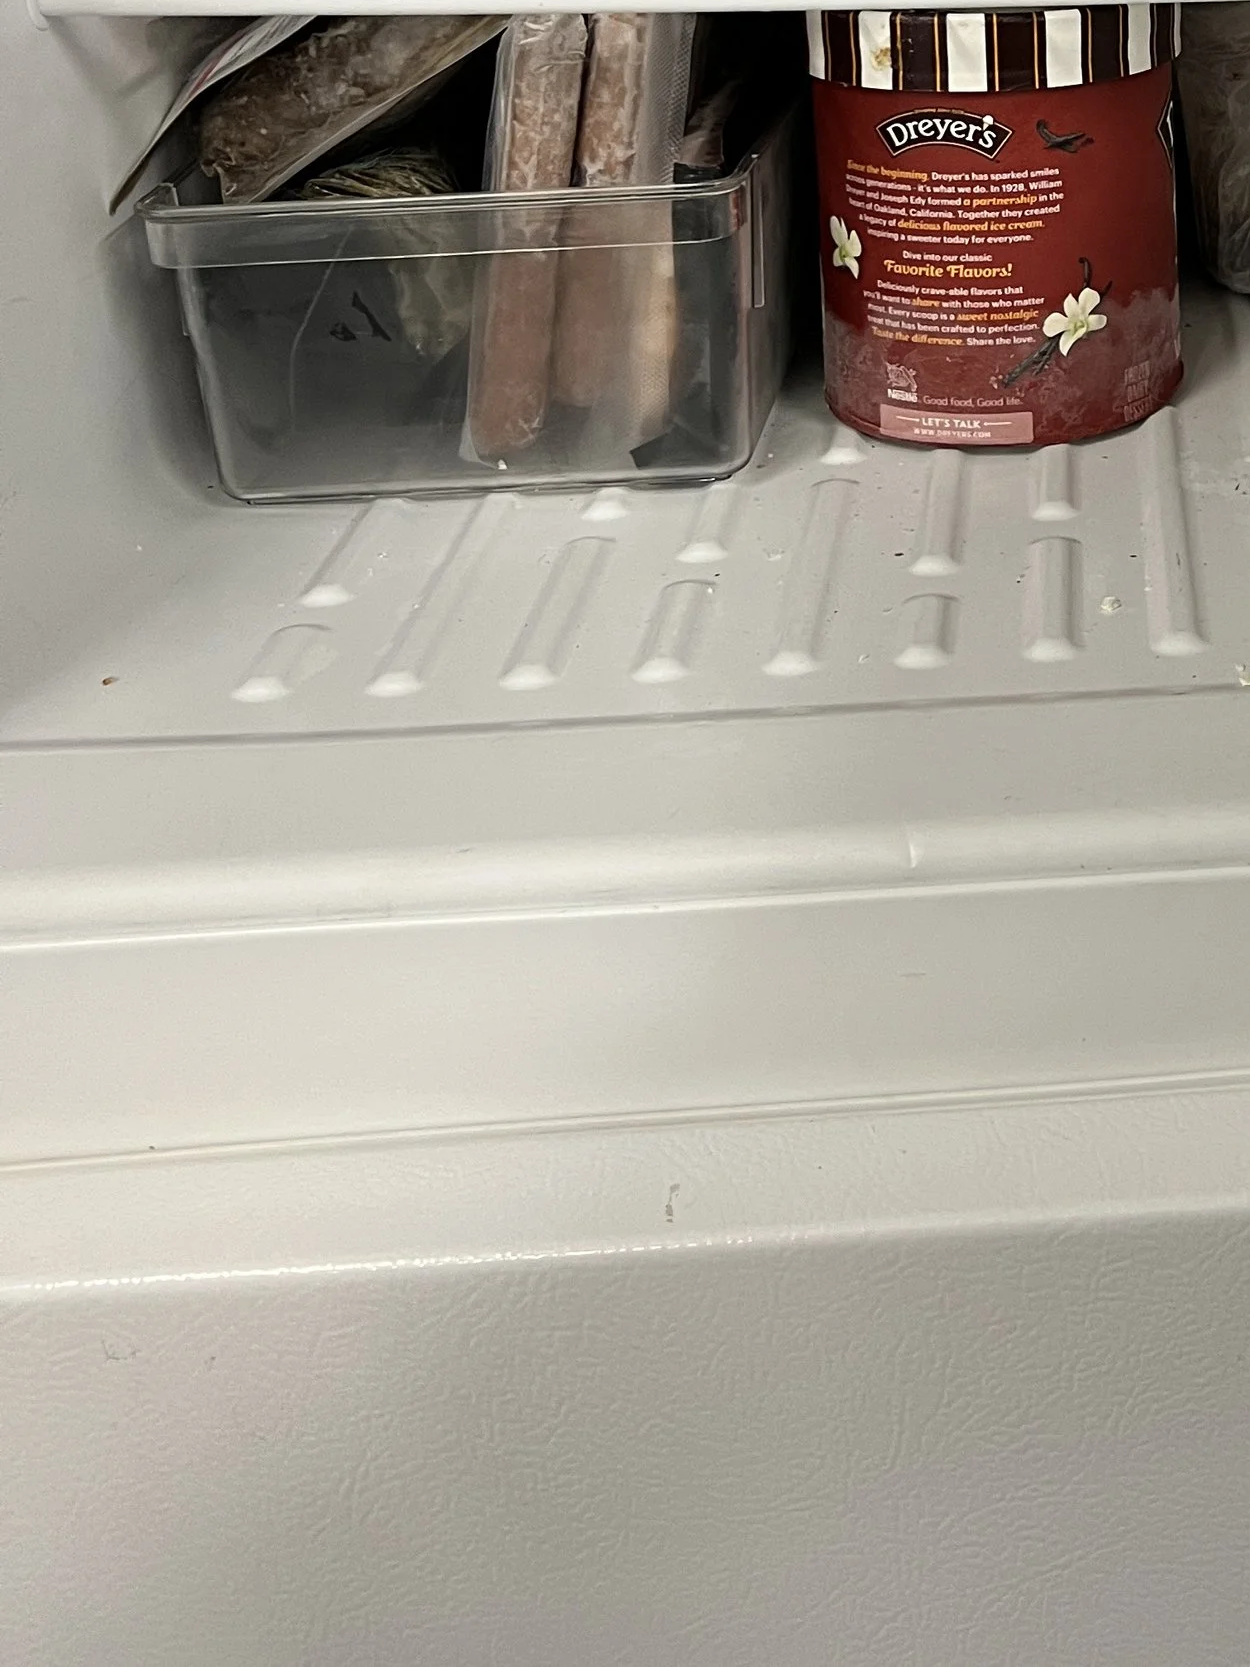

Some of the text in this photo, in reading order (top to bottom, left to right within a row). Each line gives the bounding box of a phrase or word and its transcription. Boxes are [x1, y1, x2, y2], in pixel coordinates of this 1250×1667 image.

[886, 116, 997, 149] Dreyer's
[931, 167, 1060, 183] Dreyer's has sparked smiles
[931, 185, 956, 194] what
[957, 186, 971, 194] we
[972, 185, 988, 194] do.
[990, 185, 1000, 193] In
[1029, 180, 1063, 191] William
[910, 195, 926, 206] Edy
[927, 196, 962, 206] formed
[972, 194, 1038, 209] partnership
[1038, 194, 1048, 202] in
[1049, 191, 1065, 202] the
[909, 207, 956, 219] California.
[958, 210, 1000, 221] Together
[1001, 209, 1023, 219] they
[1023, 204, 1061, 216] created
[897, 218, 942, 232] delicious
[942, 220, 988, 232] flavored
[990, 220, 1007, 231] ice
[942, 234, 970, 246] today
[971, 234, 986, 244] for
[986, 233, 1035, 245] everyone.
[902, 249, 994, 263] Dive into our classic
[883, 259, 1014, 279] Favorite Flavors!
[920, 287, 970, 297] crave-able
[970, 286, 1003, 297] flavors
[1003, 285, 1025, 295] that
[911, 296, 941, 307] share
[941, 299, 963, 309] with
[963, 299, 991, 309] those
[991, 298, 1013, 308] who
[1013, 297, 1046, 307] matter
[911, 310, 940, 322] scoop
[940, 312, 949, 321] is
[956, 311, 988, 322] sweet
[989, 308, 1040, 322] nostalgic
[916, 322, 940, 333] been
[940, 323, 975, 335] crafted
[976, 324, 987, 334] to
[987, 322, 1041, 336] perfection.
[966, 336, 995, 347] Share
[995, 336, 1012, 346] the
[1012, 335, 1038, 346] love.
[922, 394, 949, 407] Good
[949, 395, 977, 408] food,
[977, 396, 1005, 408] Good
[920, 417, 983, 431] LET'S TALK
